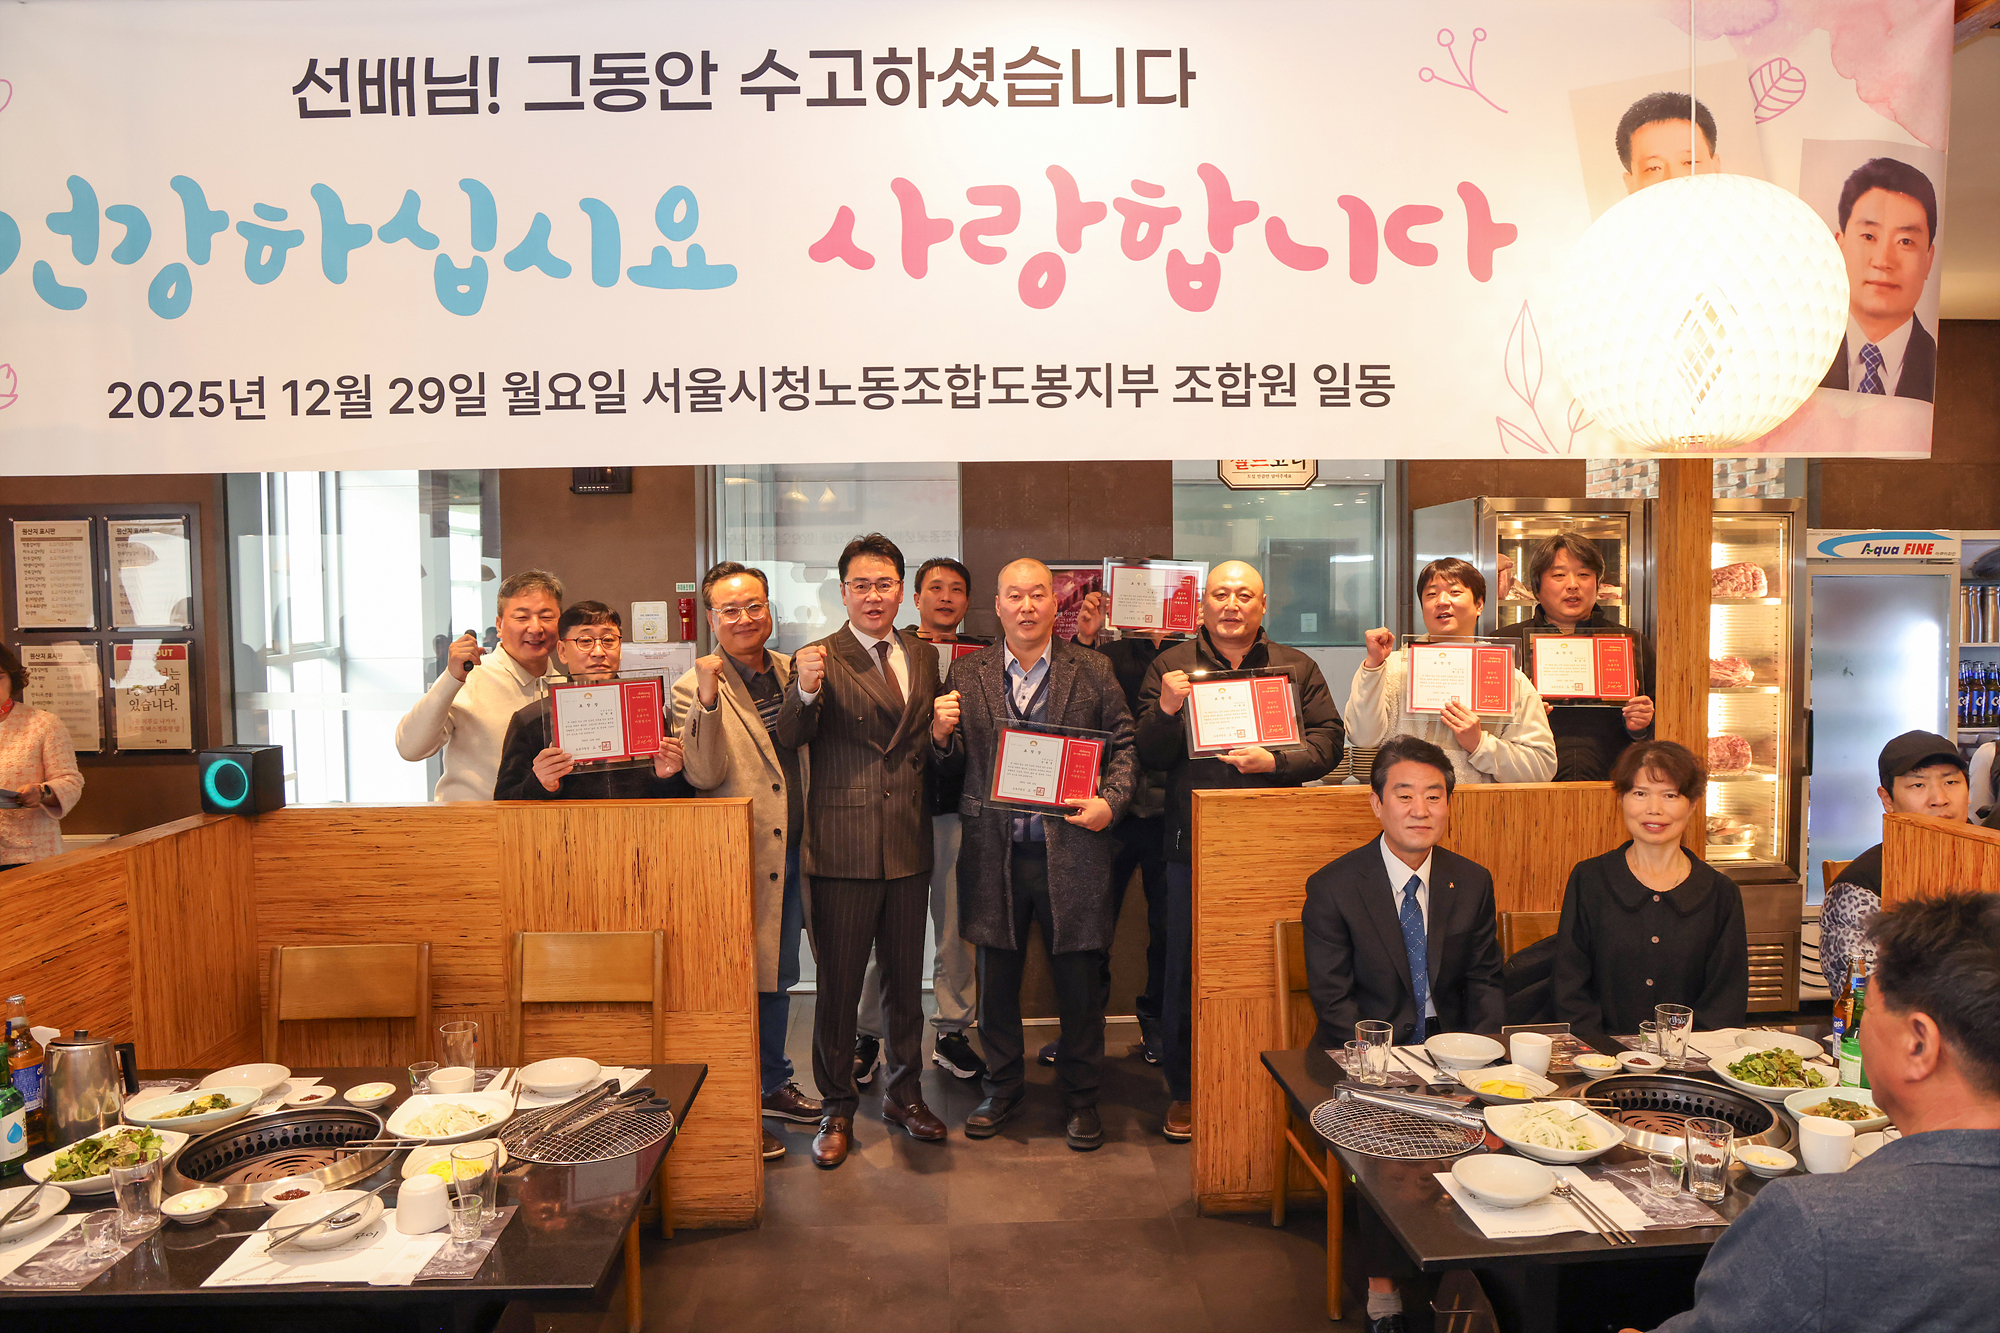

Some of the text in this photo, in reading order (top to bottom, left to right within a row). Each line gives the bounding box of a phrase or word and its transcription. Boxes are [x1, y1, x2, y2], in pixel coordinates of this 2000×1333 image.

[293, 46, 1197, 118] 선배님! 그동안 수고하셨습니다
[809, 163, 1518, 312] 사랑합니다
[108, 363, 1395, 420] 2025년 12월 29일 월요일 서울시청노동조합도봉지부 조합원 일동
[1861, 543, 1934, 556] Aqua FINE
[157, 649, 173, 657] OUT
[147, 683, 180, 696] 외부에
[129, 699, 177, 711] 있습니다.
